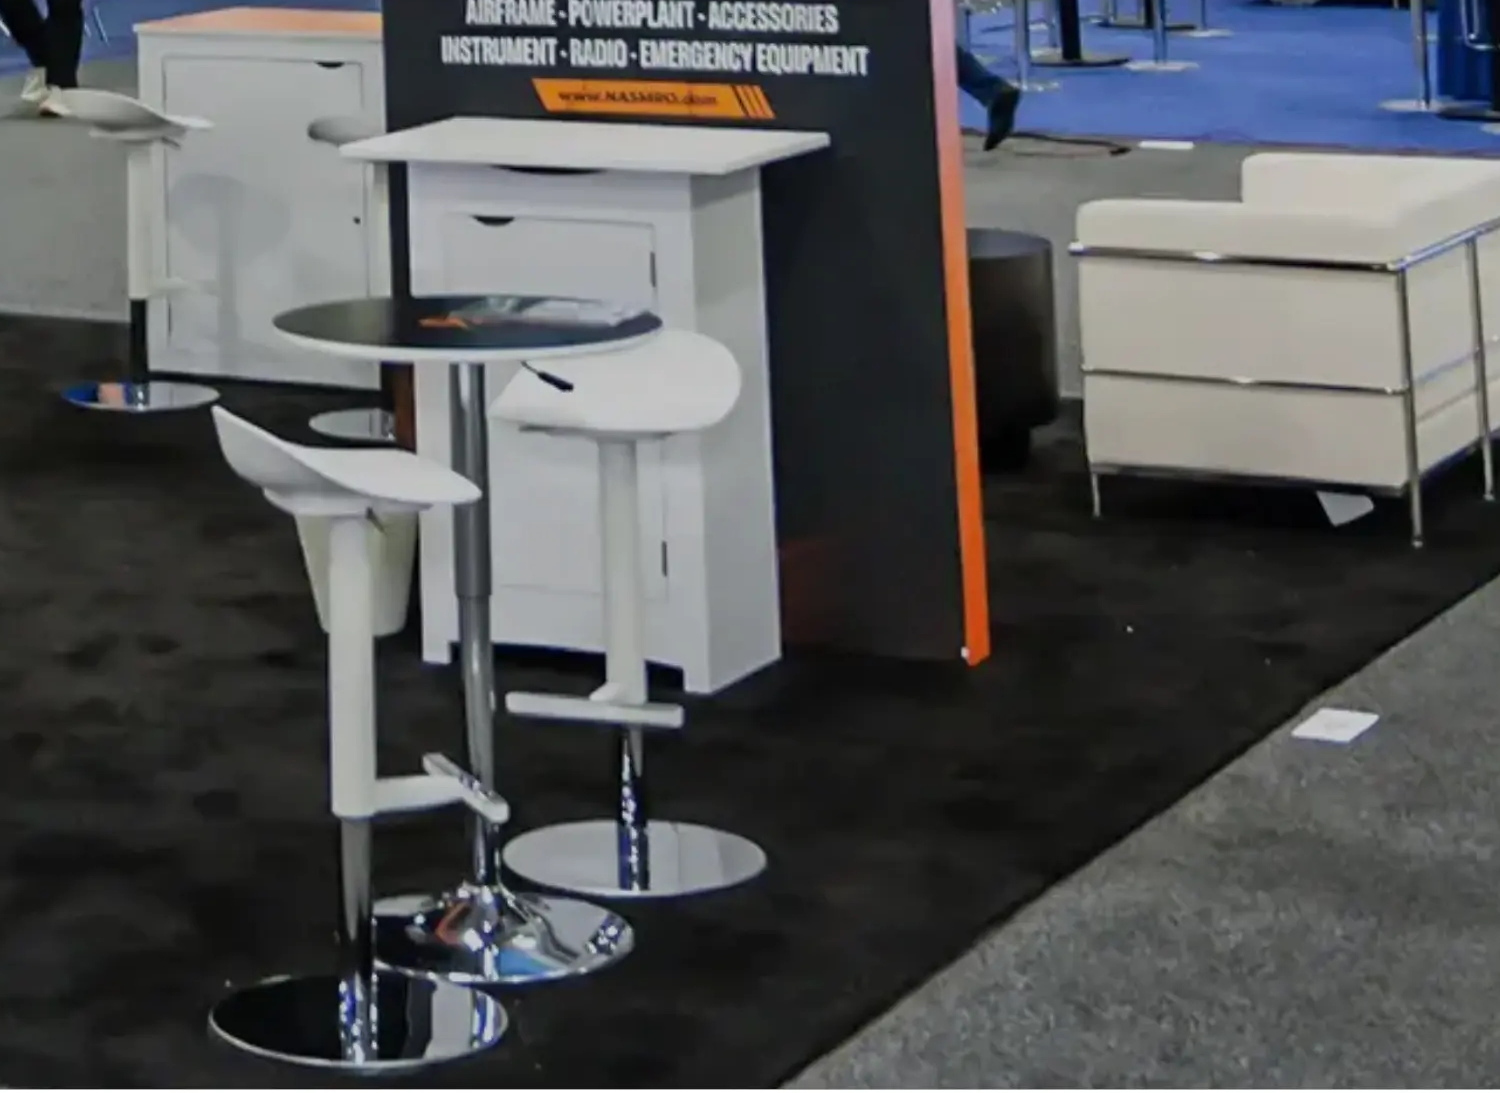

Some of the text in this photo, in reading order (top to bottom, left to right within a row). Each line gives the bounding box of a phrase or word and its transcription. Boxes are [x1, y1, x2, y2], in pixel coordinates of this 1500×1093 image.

[707, 2, 841, 35] ACCESSORIES
[440, 35, 870, 78] INSTRUMENT RADIO EMERGENCY EQUIPMENT
